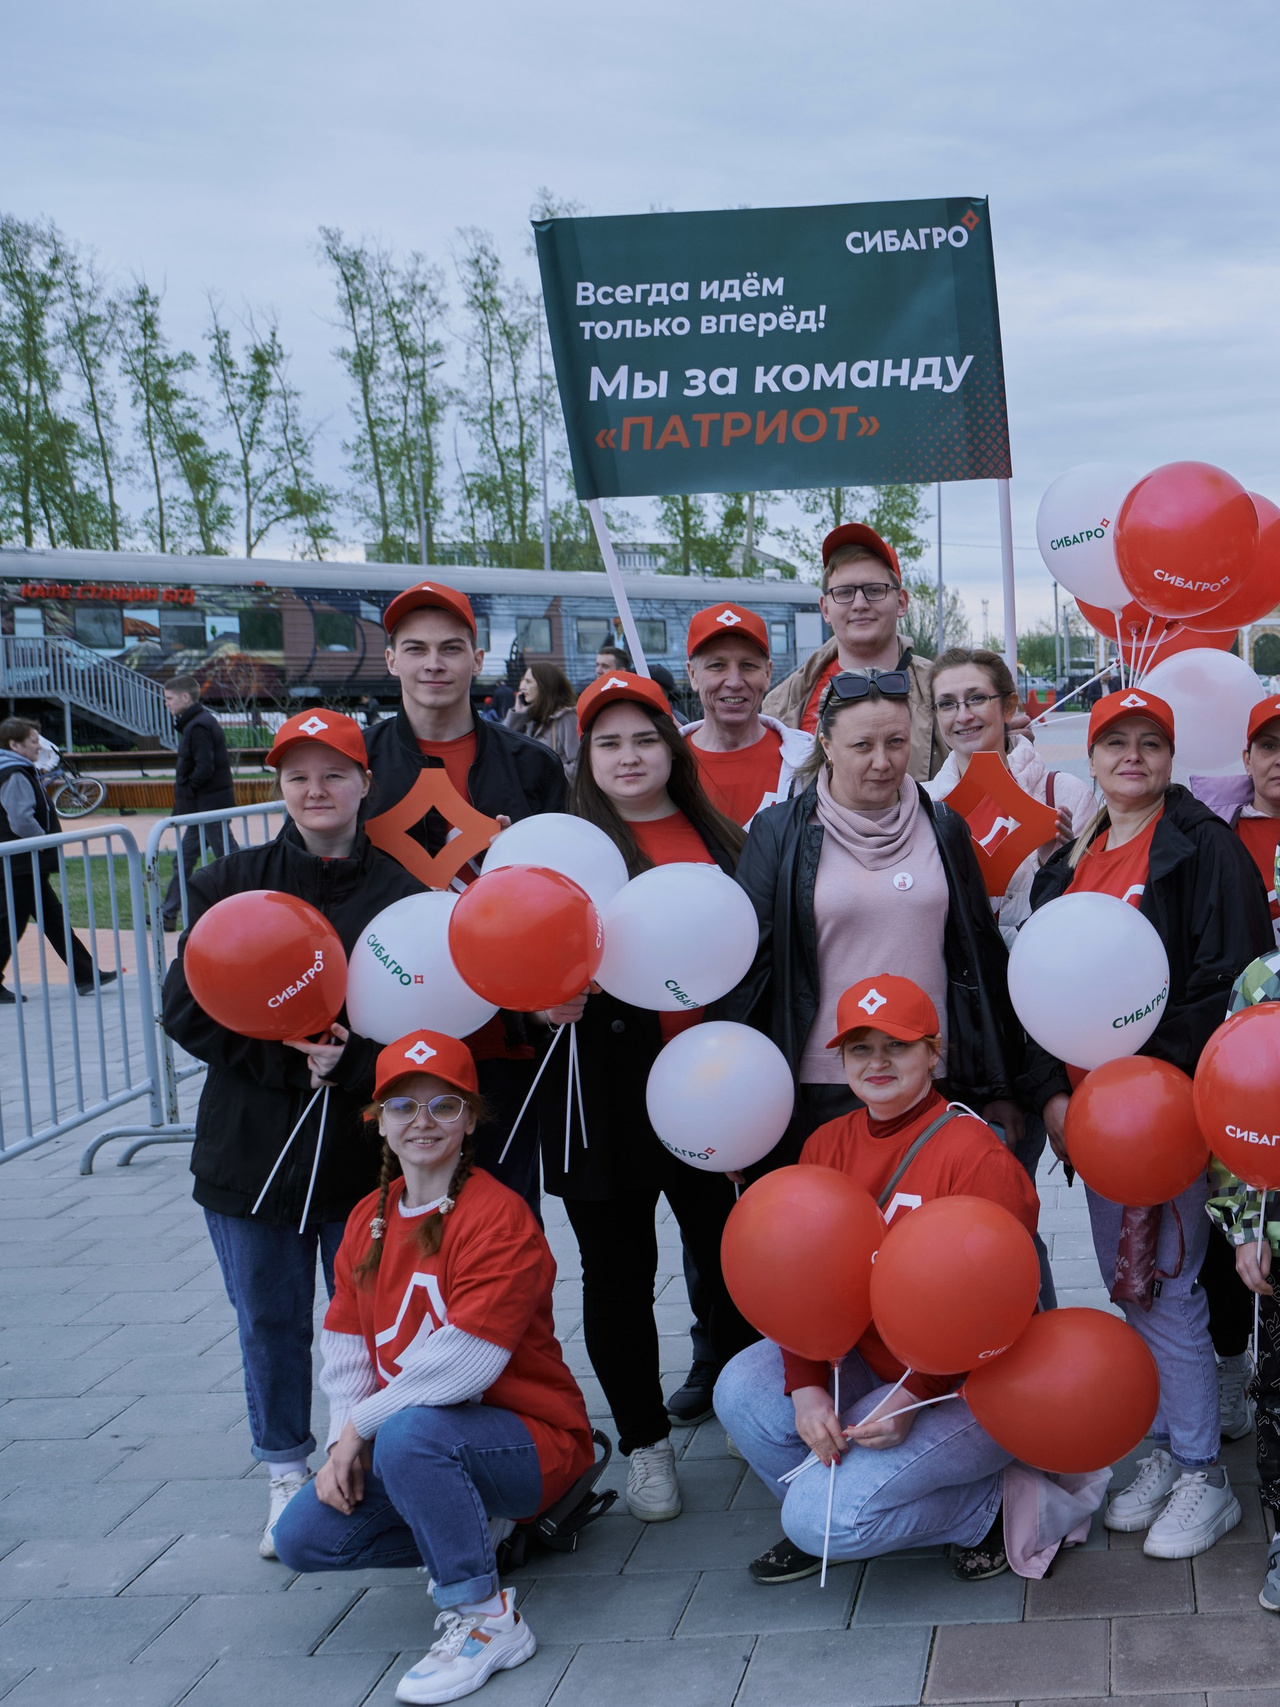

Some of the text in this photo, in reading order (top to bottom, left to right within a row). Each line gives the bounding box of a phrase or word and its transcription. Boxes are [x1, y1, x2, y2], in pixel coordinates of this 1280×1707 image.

[845, 225, 969, 254] СИБАГРО
[576, 271, 785, 306] Всегда идём
[579, 304, 827, 340] только вперёд!
[589, 355, 975, 401] Мы за команду
[595, 405, 881, 452] «ПАТРИОТ»
[1050, 527, 1105, 551] СИБАГРО
[20, 584, 73, 599] КАФЕ
[76, 585, 159, 603] СТАНЦИЯ
[1153, 569, 1221, 592] СИБАГРО
[366, 933, 412, 986] СИБАГРО
[267, 960, 324, 1008] СИБАГРО
[1112, 987, 1167, 1029] СИБАГРО
